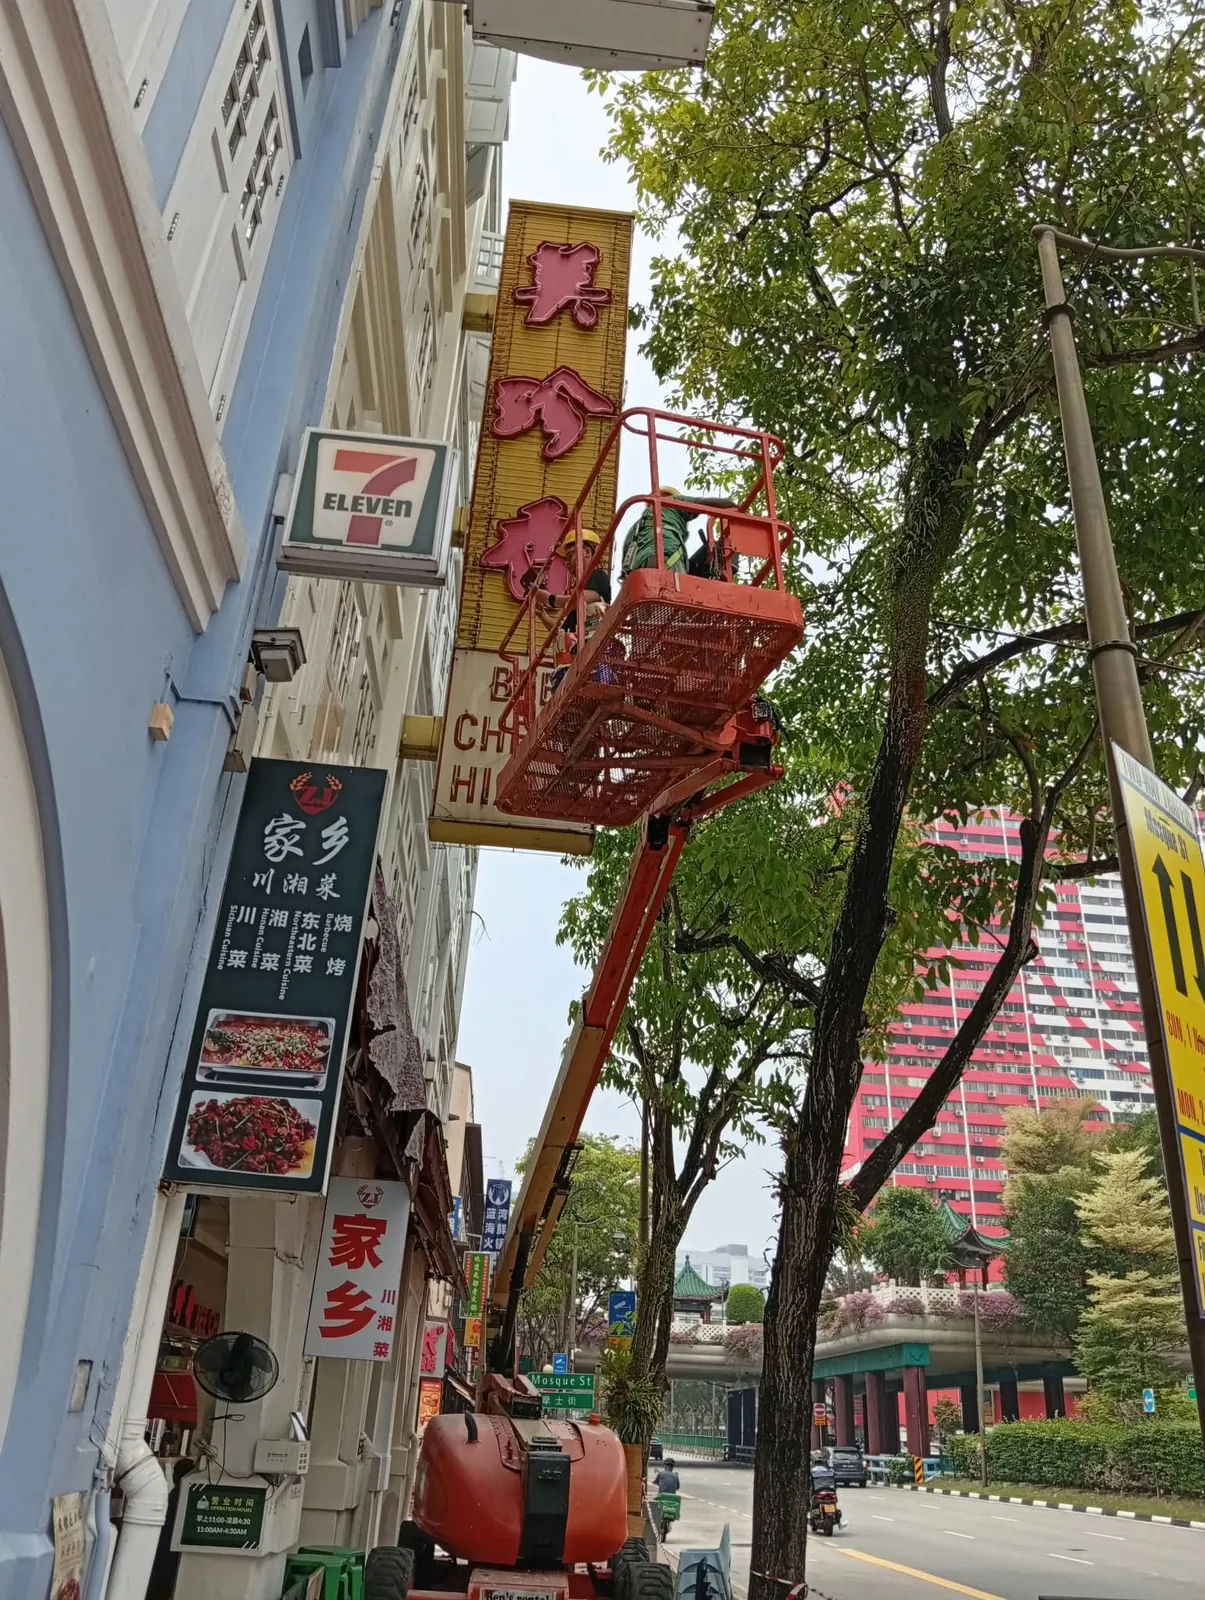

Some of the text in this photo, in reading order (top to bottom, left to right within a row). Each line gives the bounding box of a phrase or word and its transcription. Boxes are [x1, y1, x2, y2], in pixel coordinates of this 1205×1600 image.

[263, 812, 350, 866] 家乡
[252, 868, 341, 901] 川湘菜
[216, 904, 239, 970] Sichuan Cuisine
[250, 907, 271, 969] Hunan Cuisine
[278, 910, 303, 1001] Northeastern Cuisine
[292, 912, 321, 974] 东北菜
[320, 913, 335, 953] Barbecue
[318, 1213, 388, 1339] 家乡
[531, 1374, 592, 1388] Mosque St
